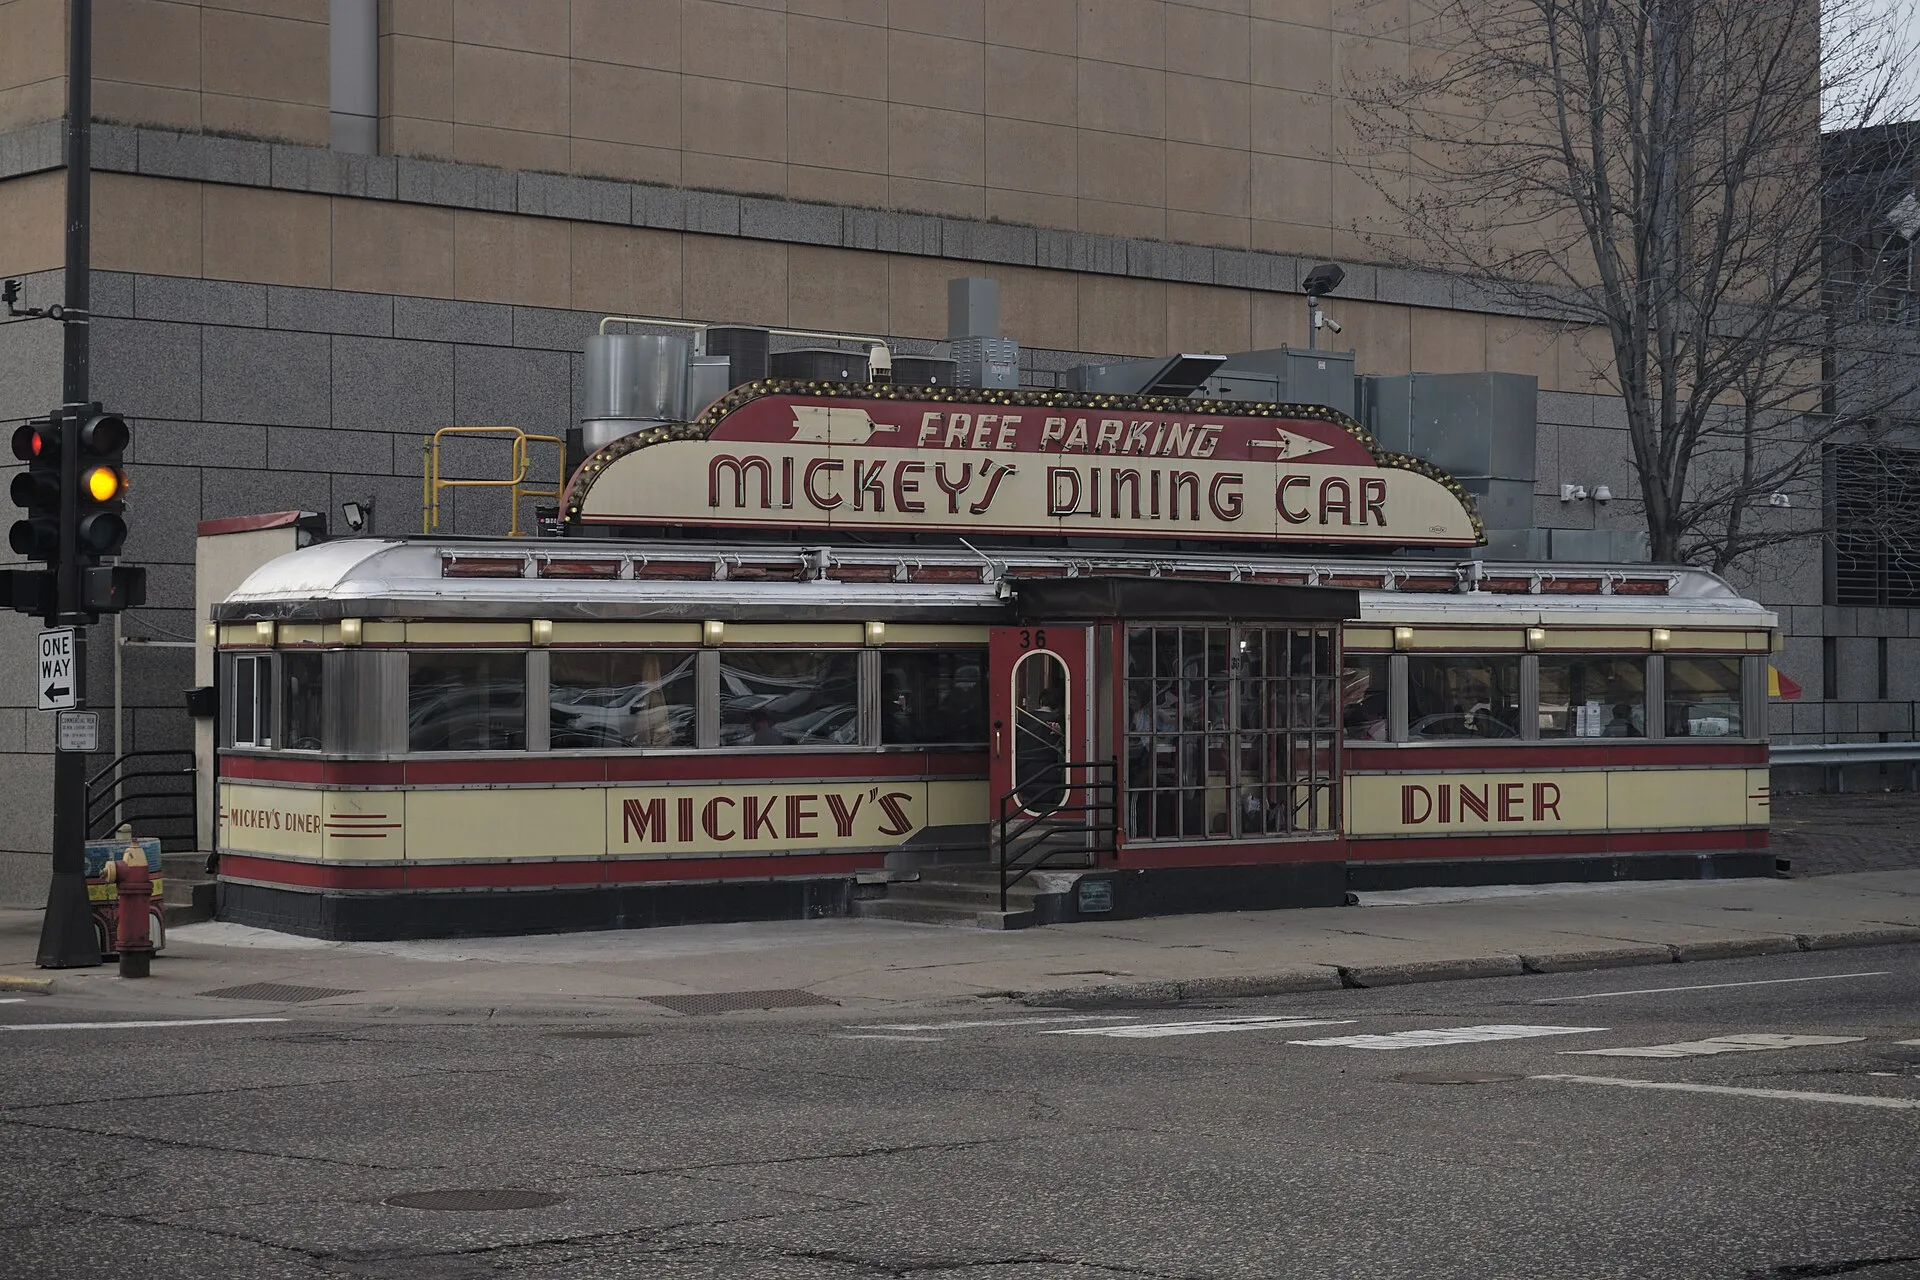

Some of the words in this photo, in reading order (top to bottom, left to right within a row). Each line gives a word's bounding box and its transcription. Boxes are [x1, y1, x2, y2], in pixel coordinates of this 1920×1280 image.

[917, 411, 1022, 450] FREE
[1038, 416, 1224, 458] PARKING
[708, 454, 1019, 514] MICKEY'S
[1047, 465, 1244, 522] DINING
[1275, 474, 1388, 526] CAR
[42, 636, 70, 657] ONE
[1019, 629, 1046, 648] 36
[42, 658, 71, 679] WAY
[623, 786, 913, 844] MICKEY'S
[1401, 781, 1562, 825] DINER
[231, 808, 281, 831] MICKEY'S
[285, 812, 321, 834] DINER
